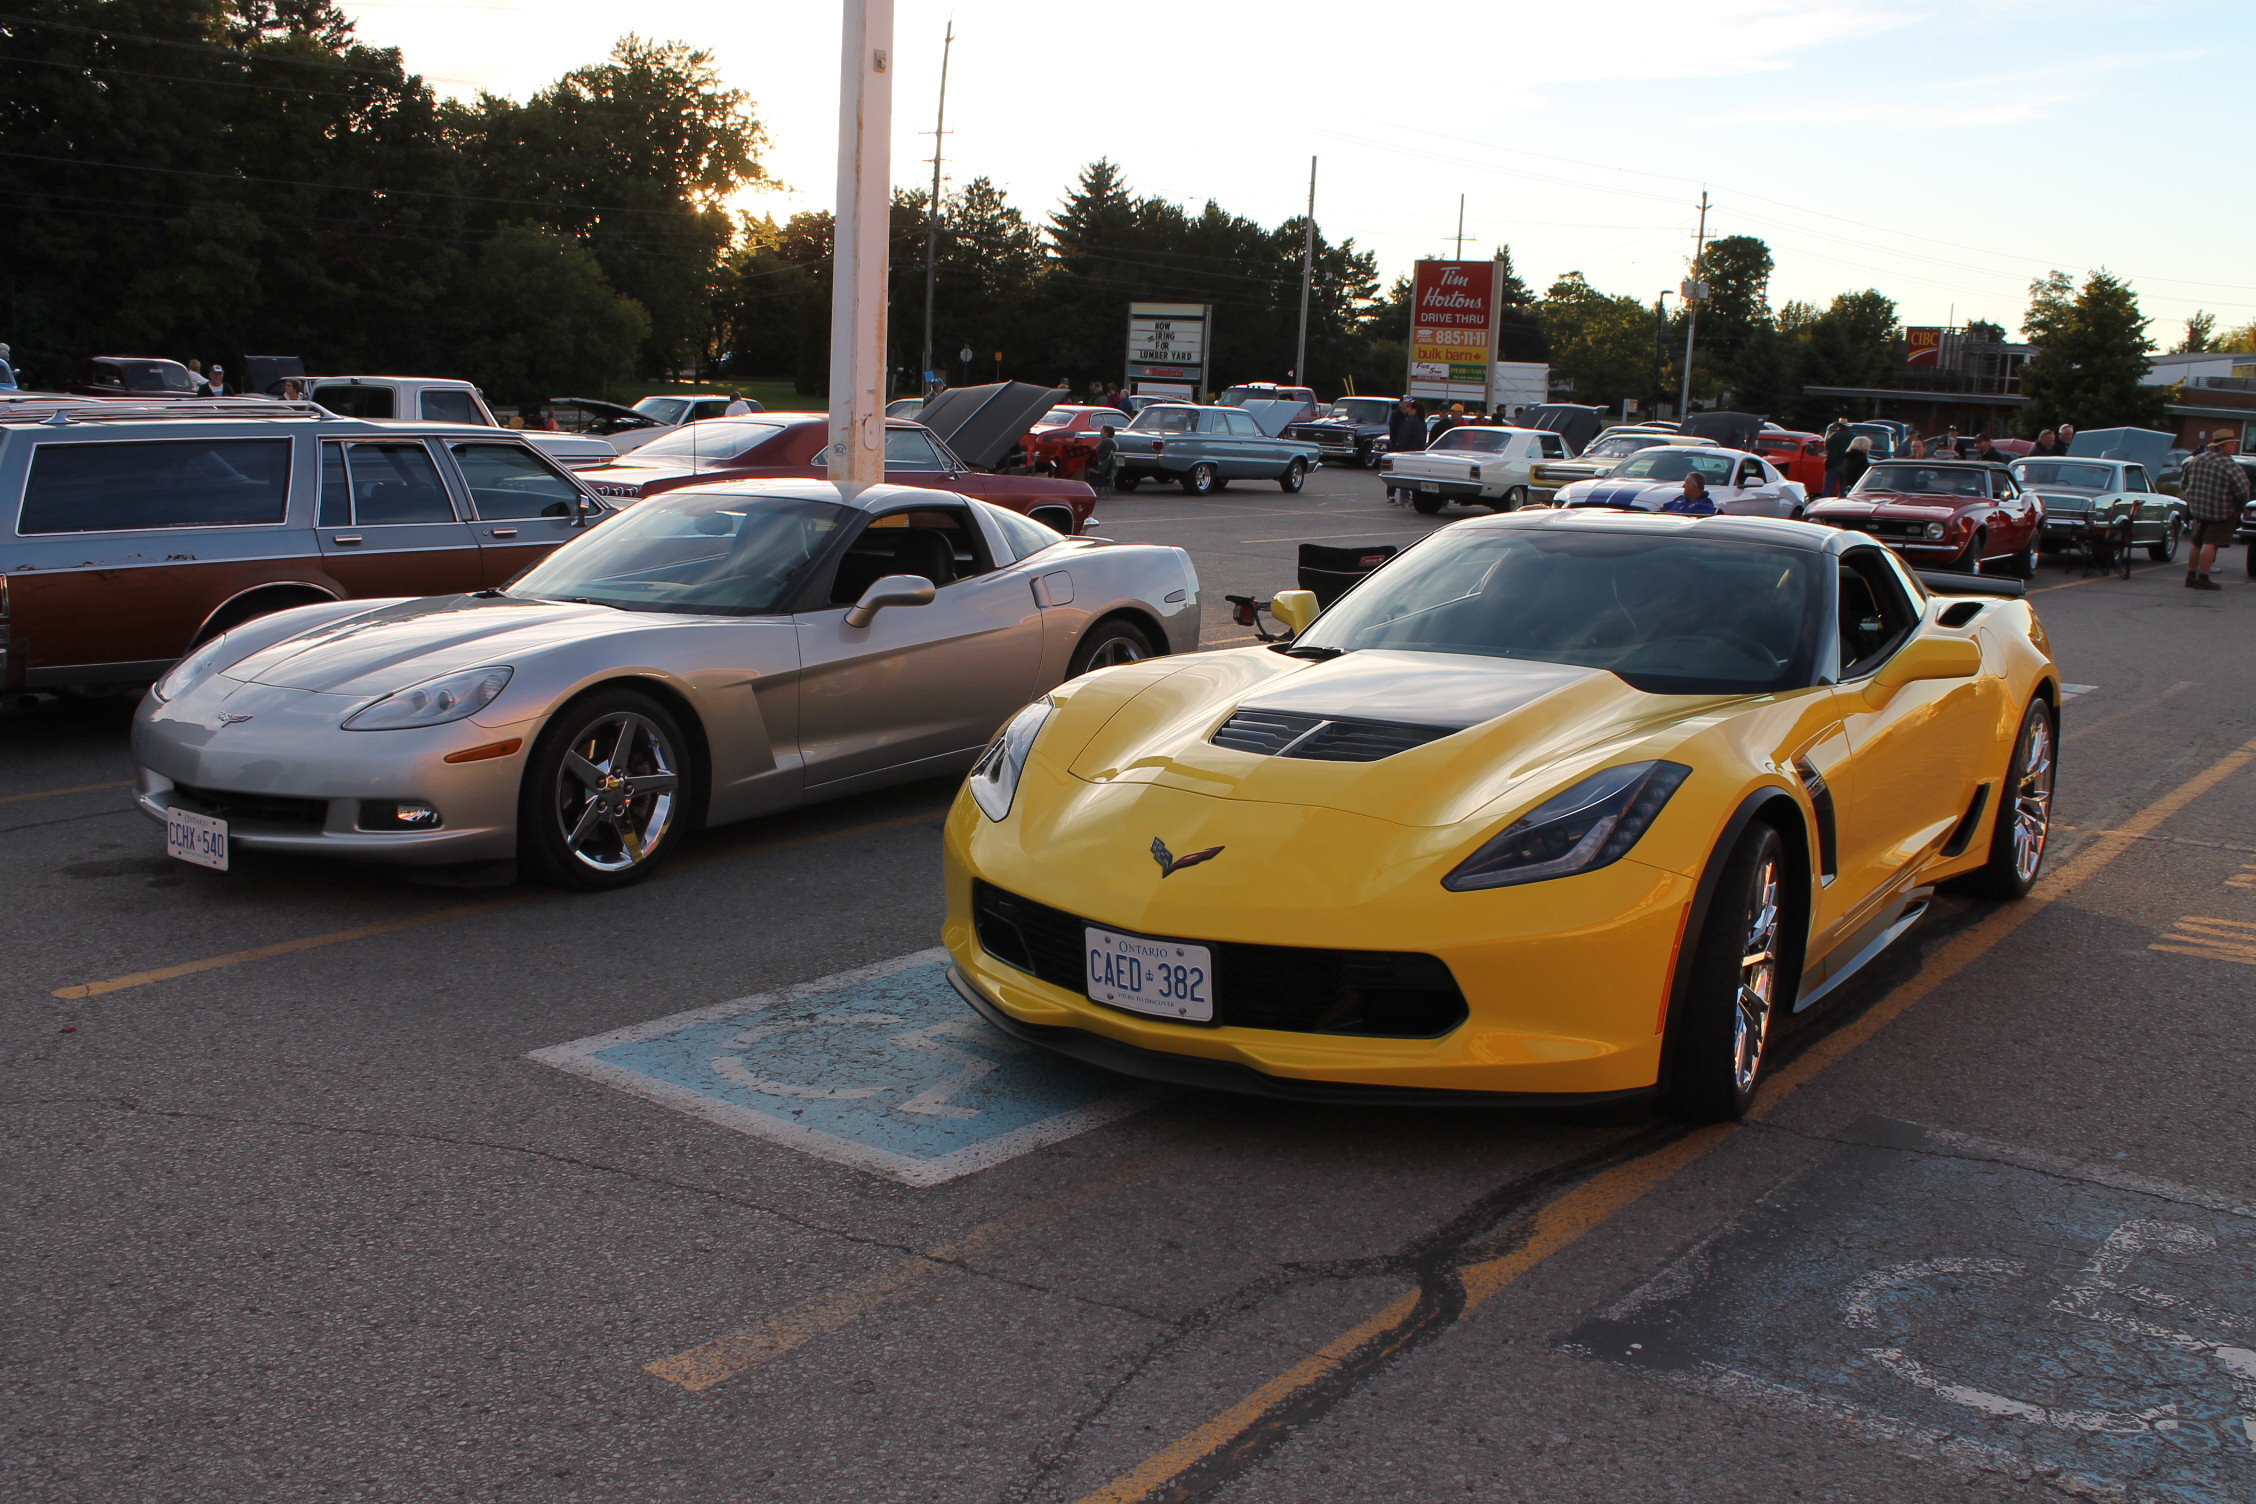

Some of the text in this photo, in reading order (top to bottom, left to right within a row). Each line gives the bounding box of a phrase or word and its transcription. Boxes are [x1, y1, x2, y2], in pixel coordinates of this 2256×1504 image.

[1440, 266, 1469, 287] Tim
[1422, 286, 1483, 309] Hortons
[1421, 312, 1484, 325] DRIVE THRU
[1154, 322, 1171, 331] NOW
[1155, 341, 1170, 350] FOR
[1911, 331, 1938, 346] CIBC
[1140, 350, 1192, 361] LUMBER YARD
[1417, 347, 1472, 361] bulk barn
[169, 821, 224, 858] CCHX 540
[1119, 941, 1168, 958] ONTARIO
[1090, 948, 1205, 1003] CAED 382
[1117, 992, 1135, 1000] YOURS
[1144, 998, 1175, 1007] DISCOVER
